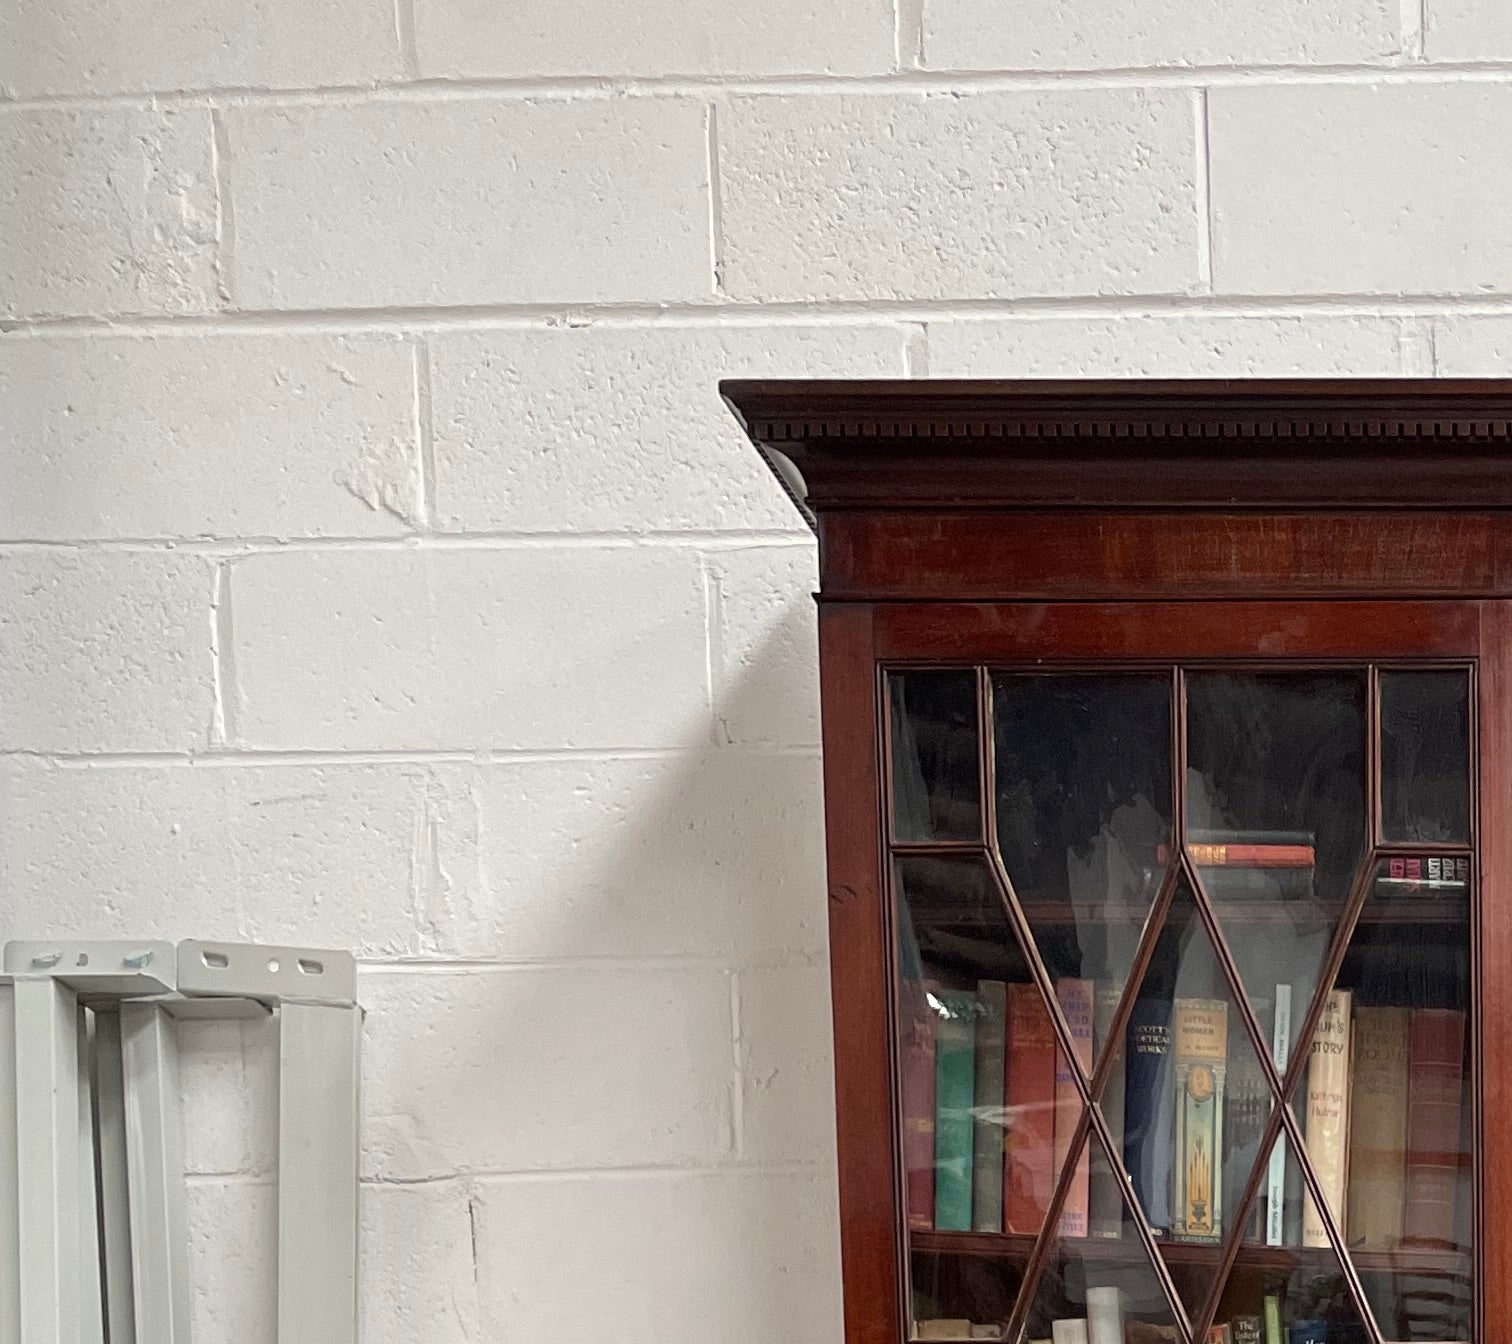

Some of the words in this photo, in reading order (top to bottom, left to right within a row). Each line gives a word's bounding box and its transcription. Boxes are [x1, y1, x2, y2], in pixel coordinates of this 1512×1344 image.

[1184, 1016, 1213, 1025] LITTLE
[1182, 1026, 1215, 1036] WOMEN
[1311, 1041, 1345, 1055] STORY
